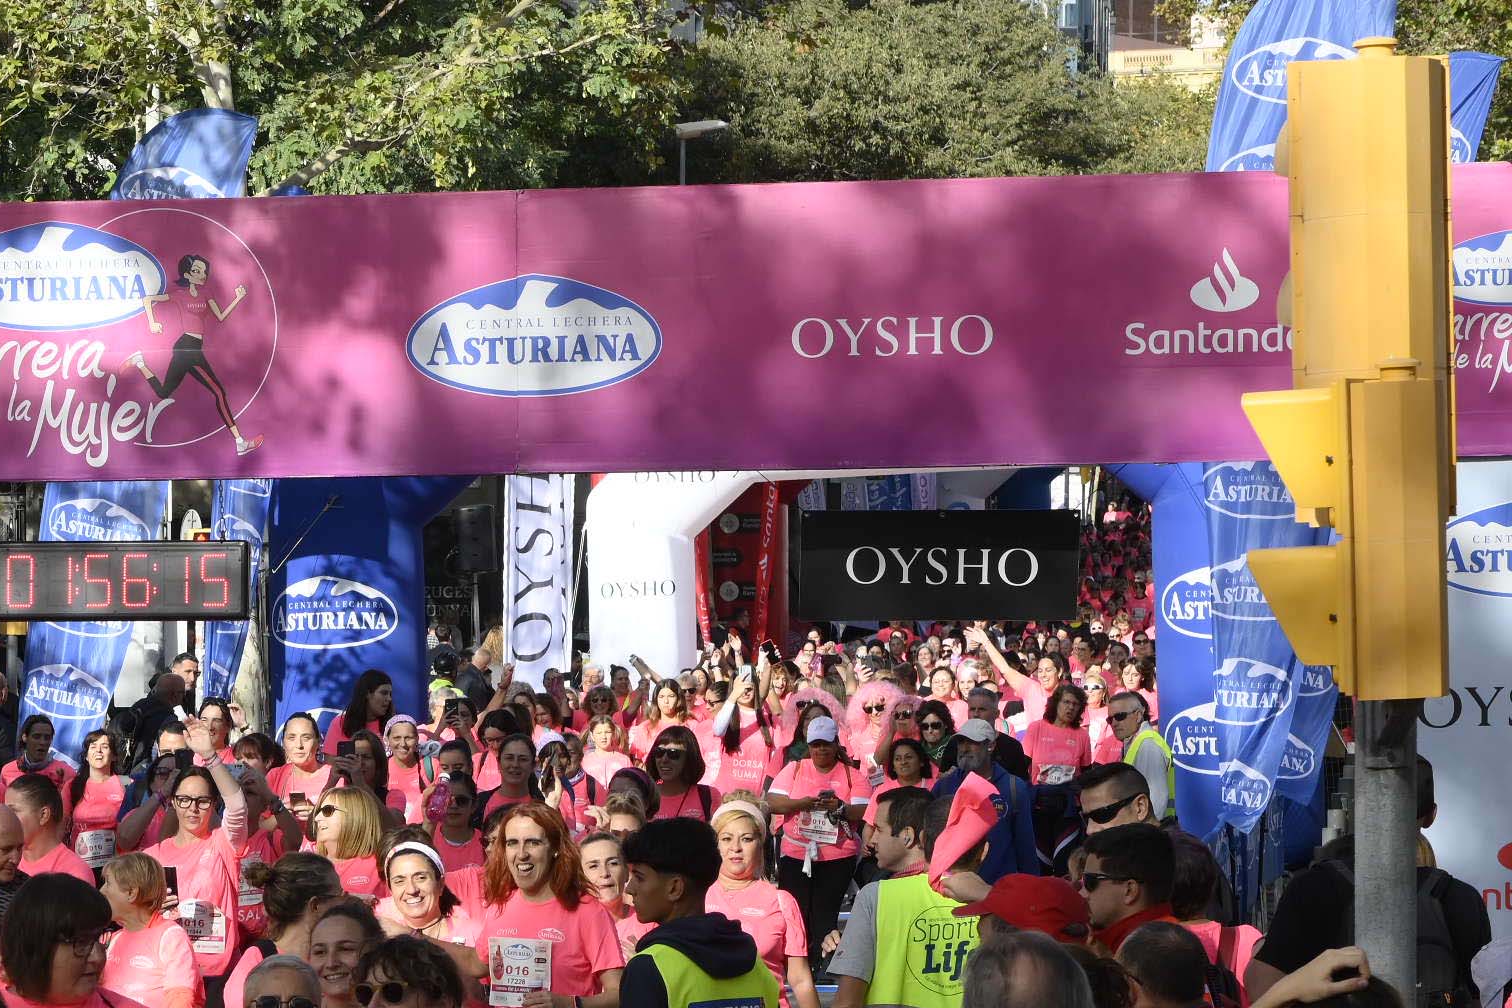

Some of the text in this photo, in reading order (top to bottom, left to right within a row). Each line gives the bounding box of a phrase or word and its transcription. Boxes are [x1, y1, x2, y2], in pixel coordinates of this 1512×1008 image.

[466, 314, 633, 330] CENTRAL LECHERA
[791, 314, 994, 358] OYSHO
[426, 322, 642, 366] ASTURIANA
[1125, 323, 1292, 355] Santand
[1475, 340, 1493, 369] la
[7, 380, 32, 422] la
[27, 375, 175, 468] Mujer
[1208, 475, 1292, 502] ASTURIA
[1473, 535, 1512, 544] CENT
[6, 553, 229, 608] 01:56:15
[512, 475, 554, 662] OYSH
[846, 546, 1039, 587] OYSHO
[601, 580, 676, 598] OYSHO
[276, 605, 390, 632] ASTURIANA
[288, 600, 385, 610] CENTRAL LECHERA
[28, 679, 104, 713] ASTURIANA
[732, 770, 758, 779] SUMA
[733, 759, 764, 769] DORSA
[914, 917, 976, 945] Sport
[506, 966, 530, 975] 016
[922, 941, 970, 981] Lif
